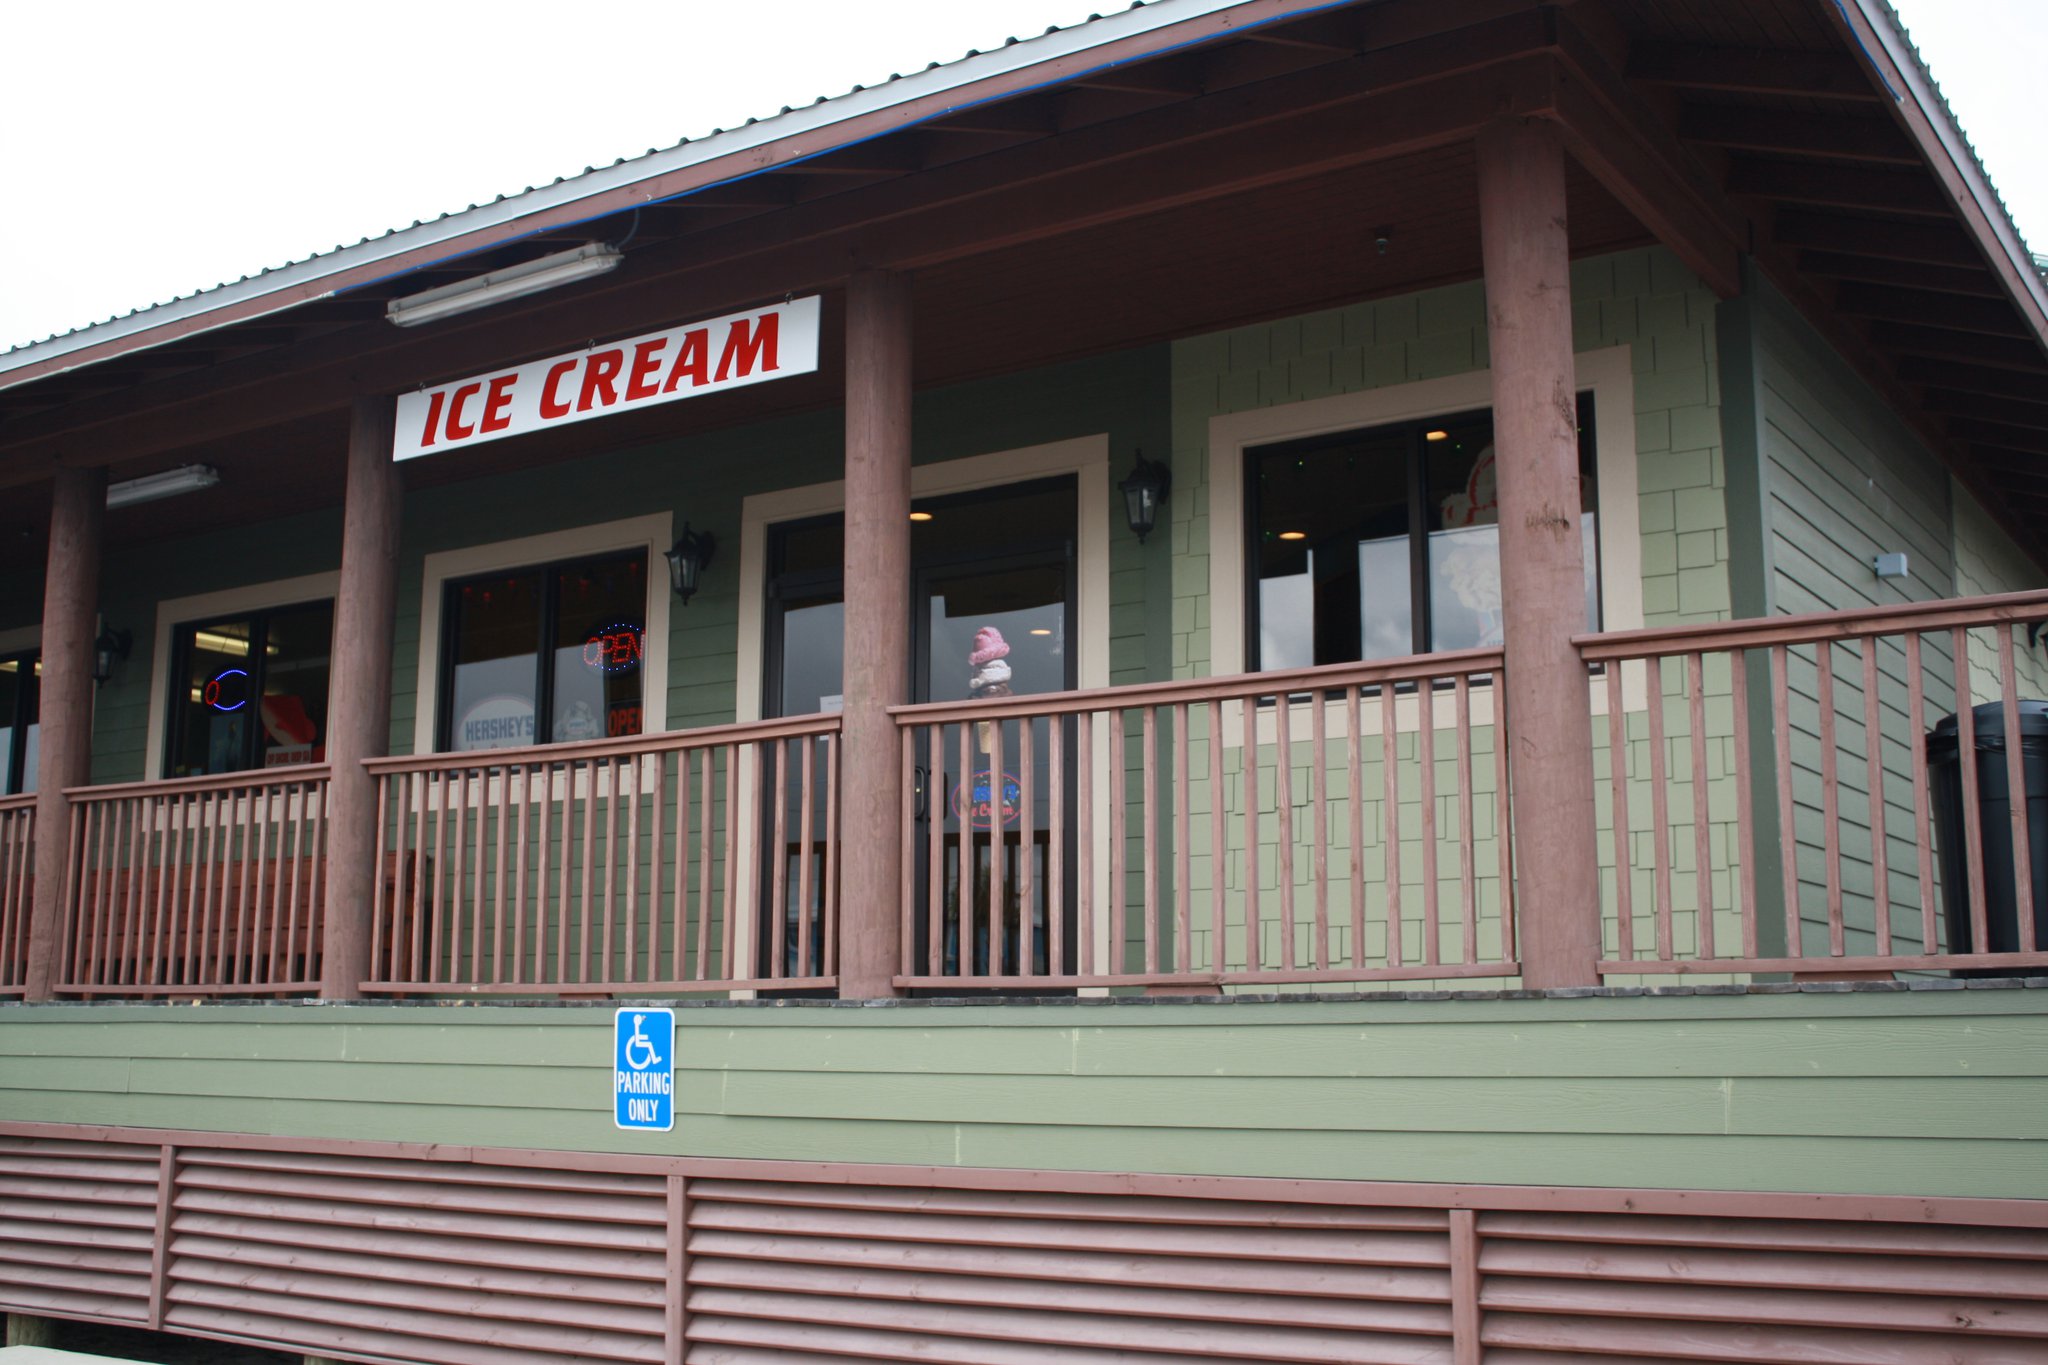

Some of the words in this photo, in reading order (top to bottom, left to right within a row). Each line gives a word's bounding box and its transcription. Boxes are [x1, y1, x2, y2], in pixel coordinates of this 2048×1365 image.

[420, 373, 518, 447] ICE
[539, 312, 780, 420] CREAM
[583, 629, 646, 666] OPEN
[465, 714, 534, 743] HERSHEY'S
[617, 1071, 670, 1095] PARKING
[628, 1098, 658, 1122] ONLY
